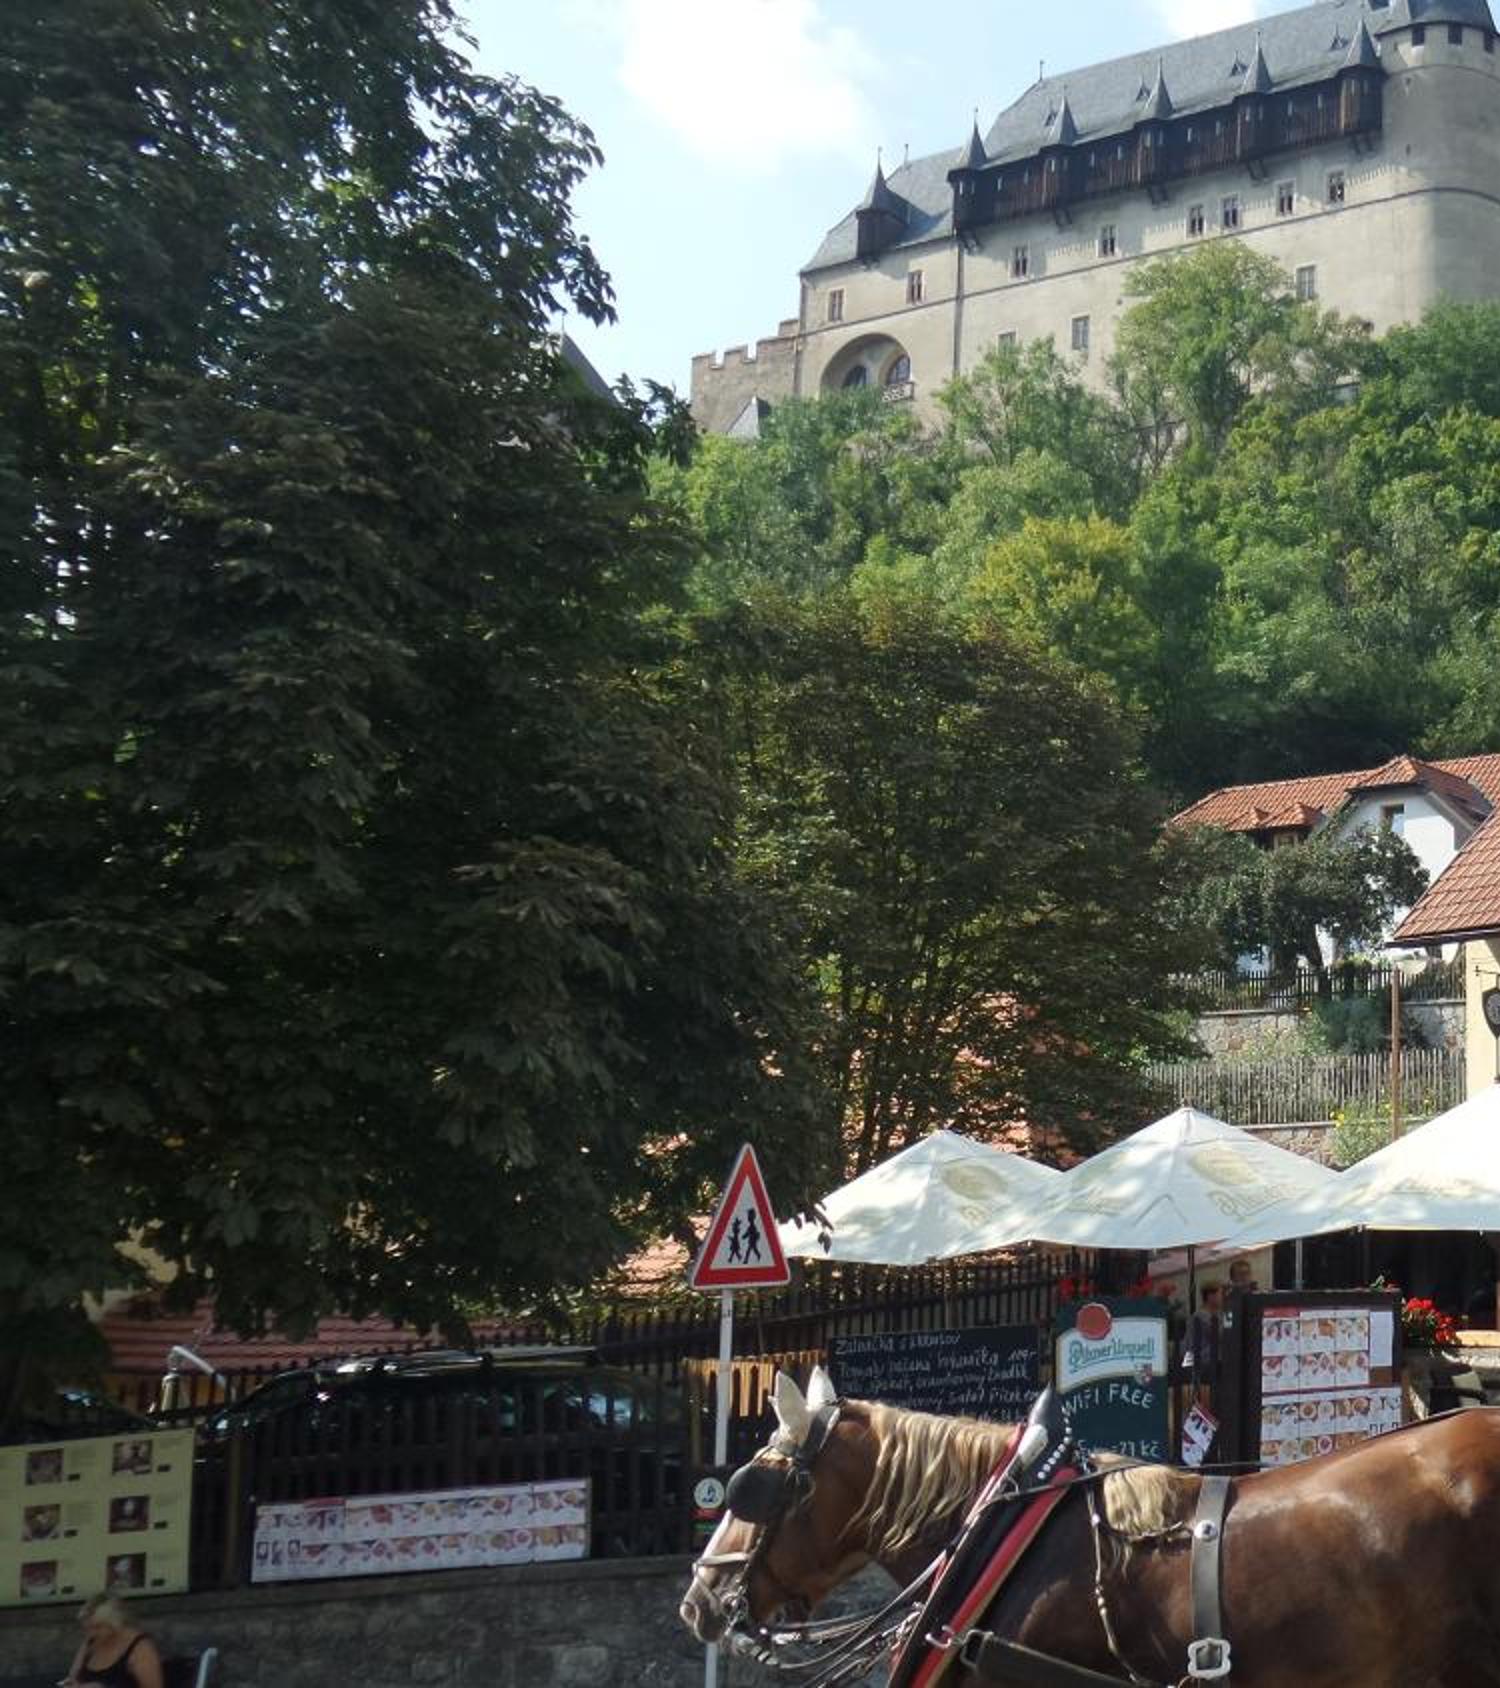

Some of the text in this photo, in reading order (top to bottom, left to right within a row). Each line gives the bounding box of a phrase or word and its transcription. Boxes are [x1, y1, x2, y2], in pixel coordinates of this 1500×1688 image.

[1069, 1335, 1155, 1369] Pilsner Urquell
[1109, 1383, 1154, 1409] FREE
